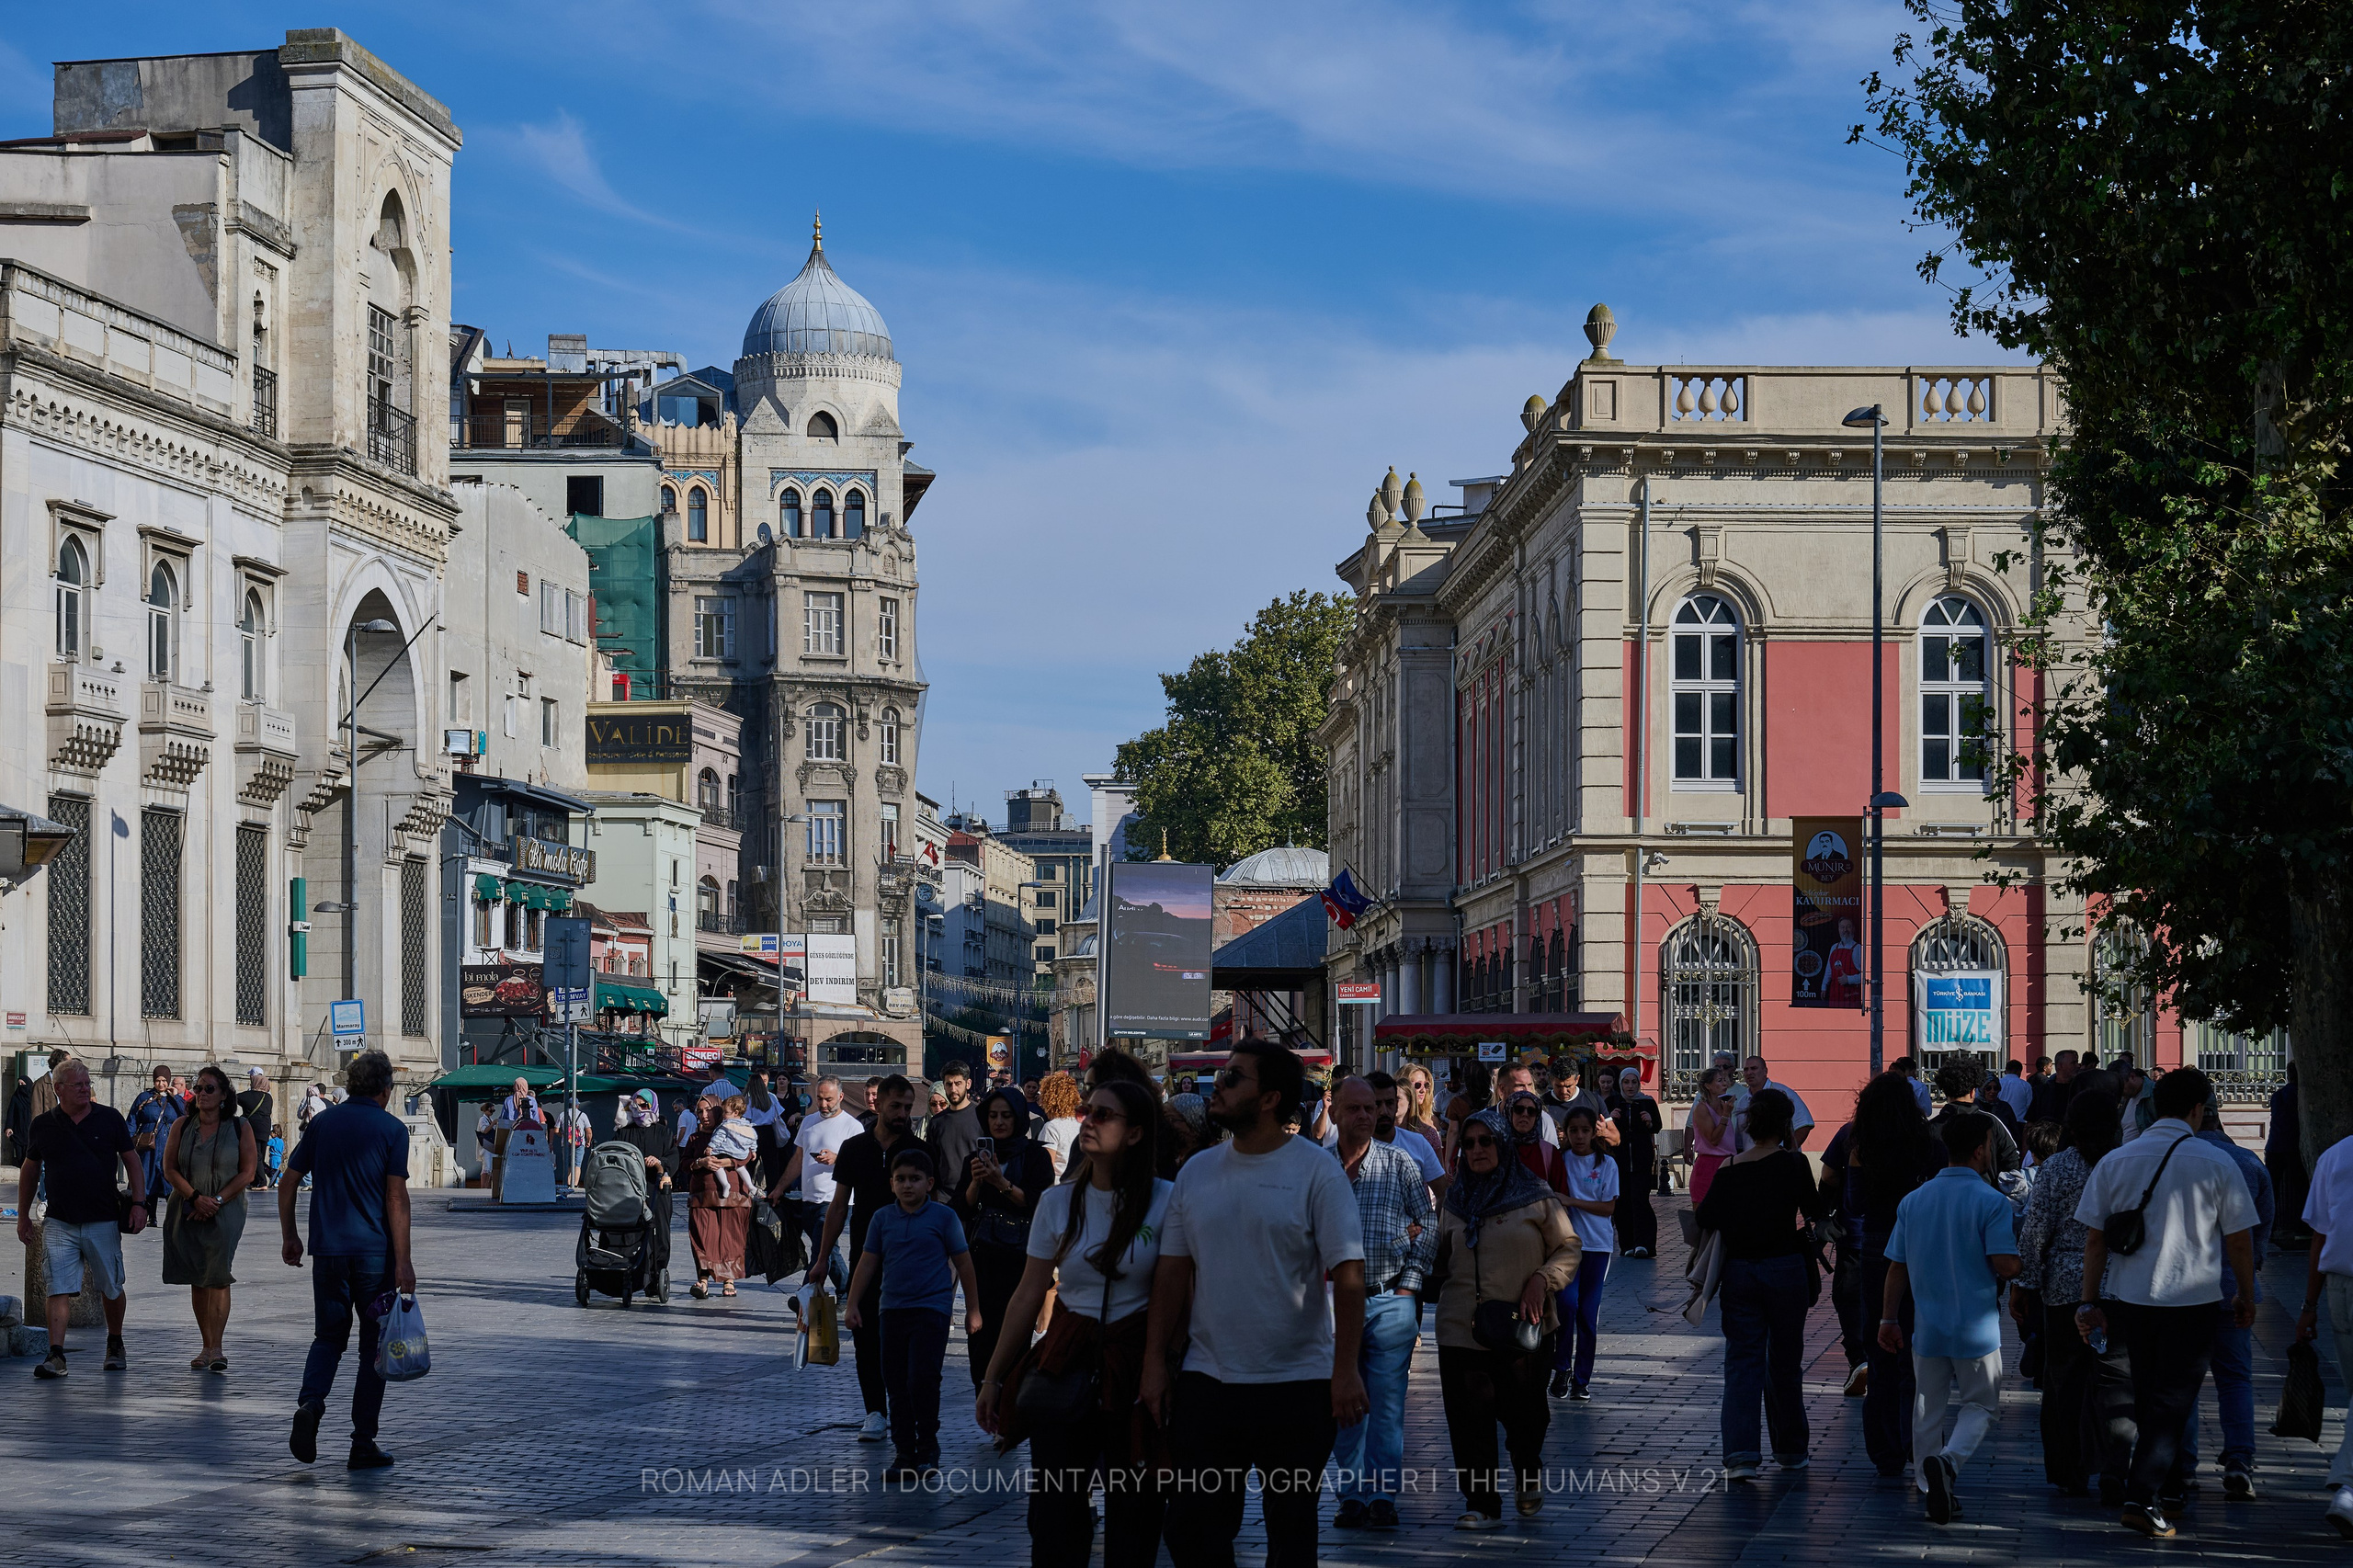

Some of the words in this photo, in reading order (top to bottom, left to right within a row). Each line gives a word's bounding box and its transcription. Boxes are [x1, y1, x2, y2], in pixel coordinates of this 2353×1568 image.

[1807, 861, 1847, 873] MÜNİR
[1796, 896, 1859, 905] KAVURMACI
[809, 951, 825, 960] GÜNEŞ
[825, 951, 854, 960] GÖZLÜĞÜNDE
[825, 975, 855, 985] İNDİRİM
[557, 993, 586, 1002] TRMVAY
[1927, 1011, 1991, 1042] MÜZE
[687, 1048, 721, 1060] SİRKECİ
[687, 1061, 710, 1069] MARKE
